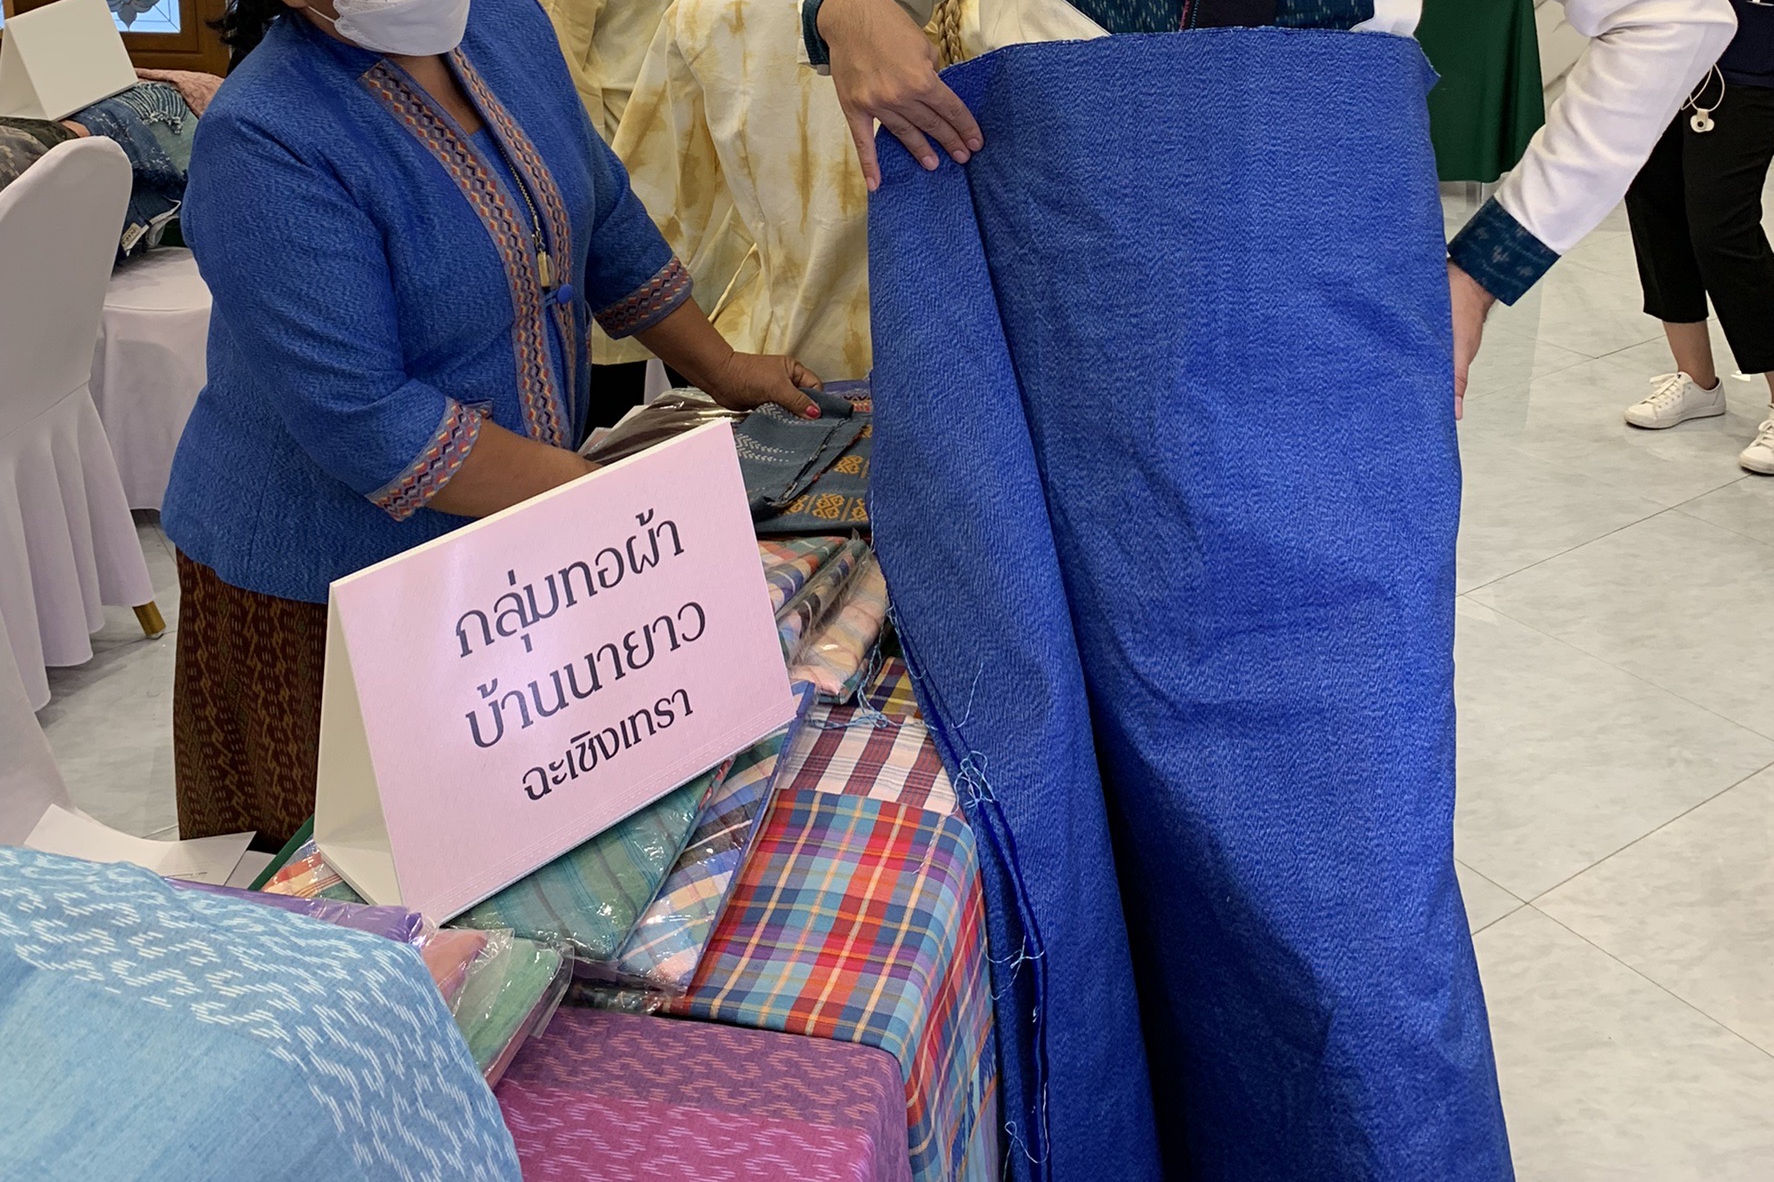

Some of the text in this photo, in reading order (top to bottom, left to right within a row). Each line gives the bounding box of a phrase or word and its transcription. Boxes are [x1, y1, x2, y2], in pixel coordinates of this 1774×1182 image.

[456, 508, 684, 657] กลุ่มทอผ้า
[466, 601, 706, 749] บ้านนายาว
[522, 688, 694, 801] ฉะเชิงเทรา
